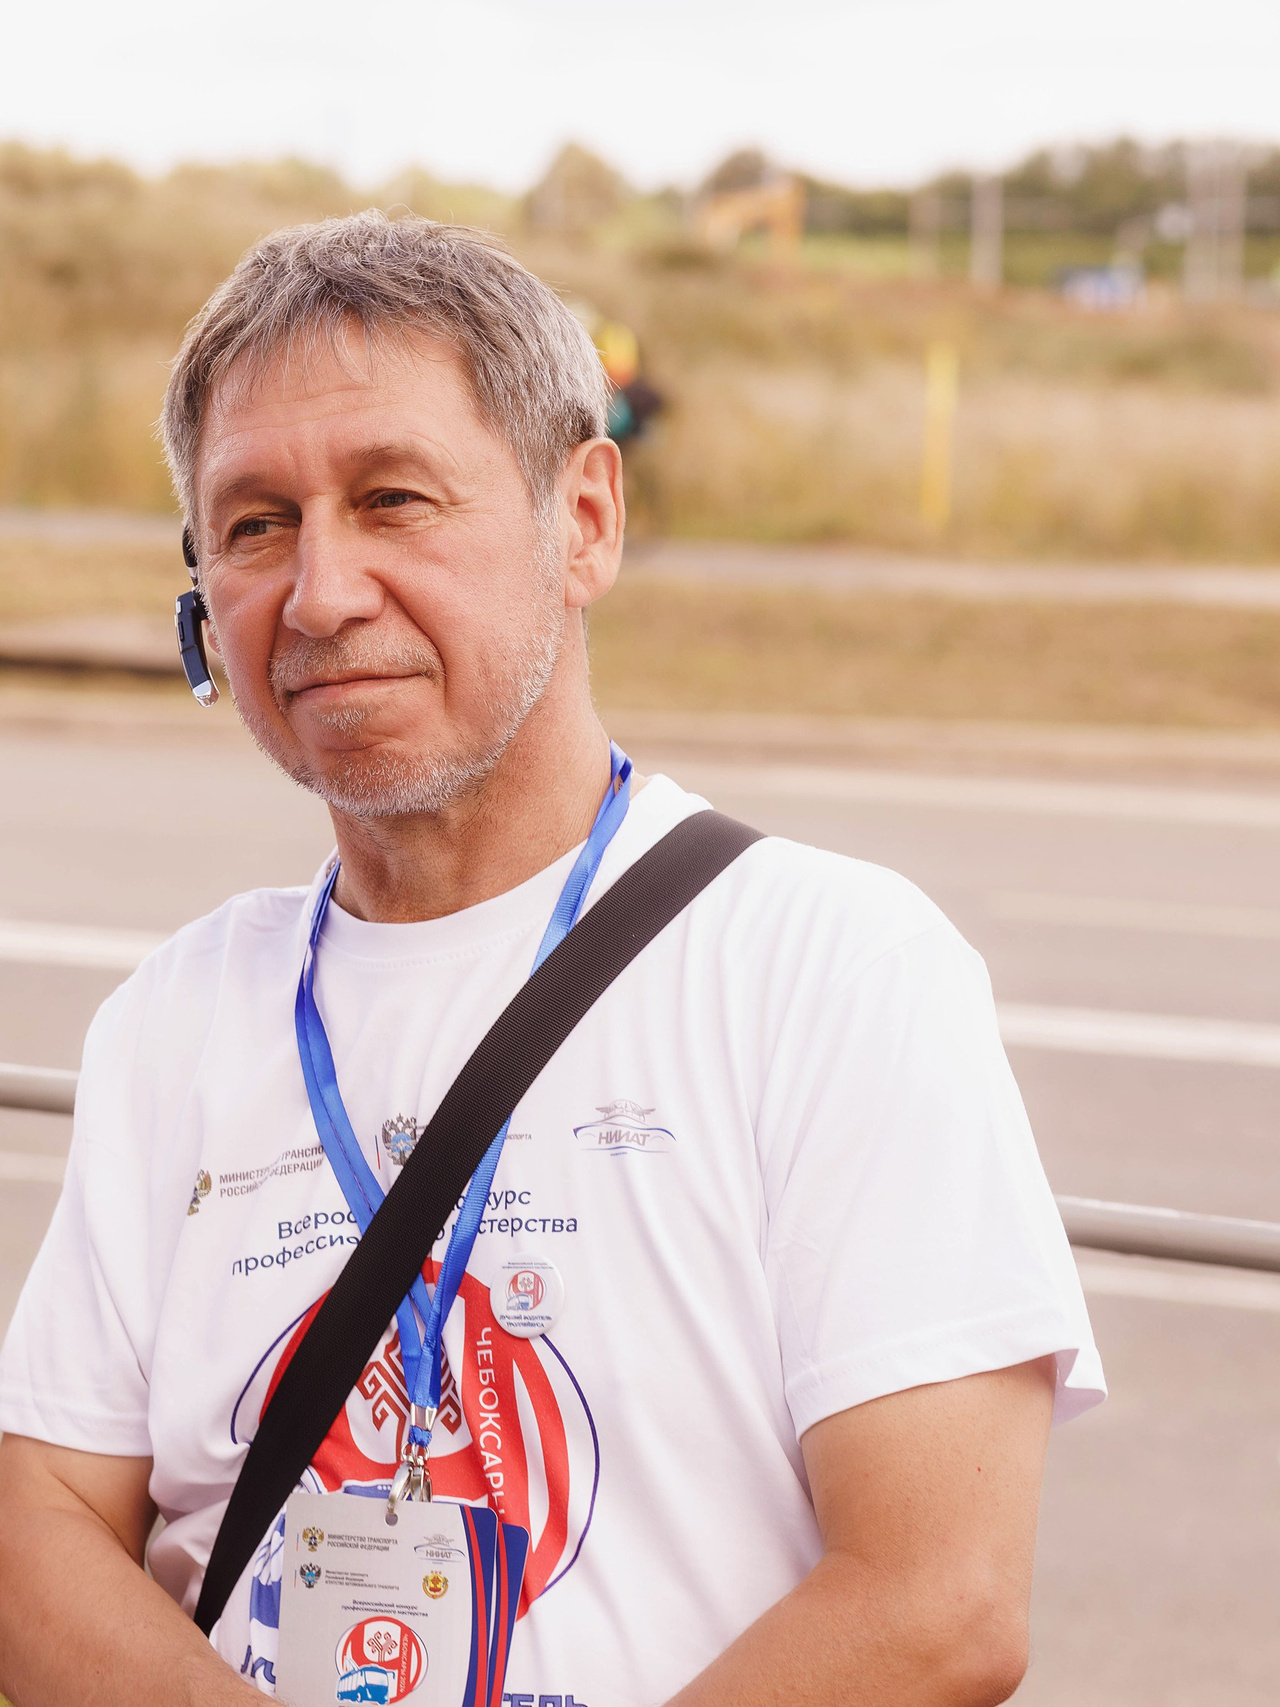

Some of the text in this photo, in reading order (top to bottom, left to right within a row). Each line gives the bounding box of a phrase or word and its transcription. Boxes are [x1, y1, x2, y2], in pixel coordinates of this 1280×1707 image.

[598, 1129, 651, 1146] НИИАТ
[451, 1216, 578, 1238] стерства
[231, 1234, 360, 1277] профессио
